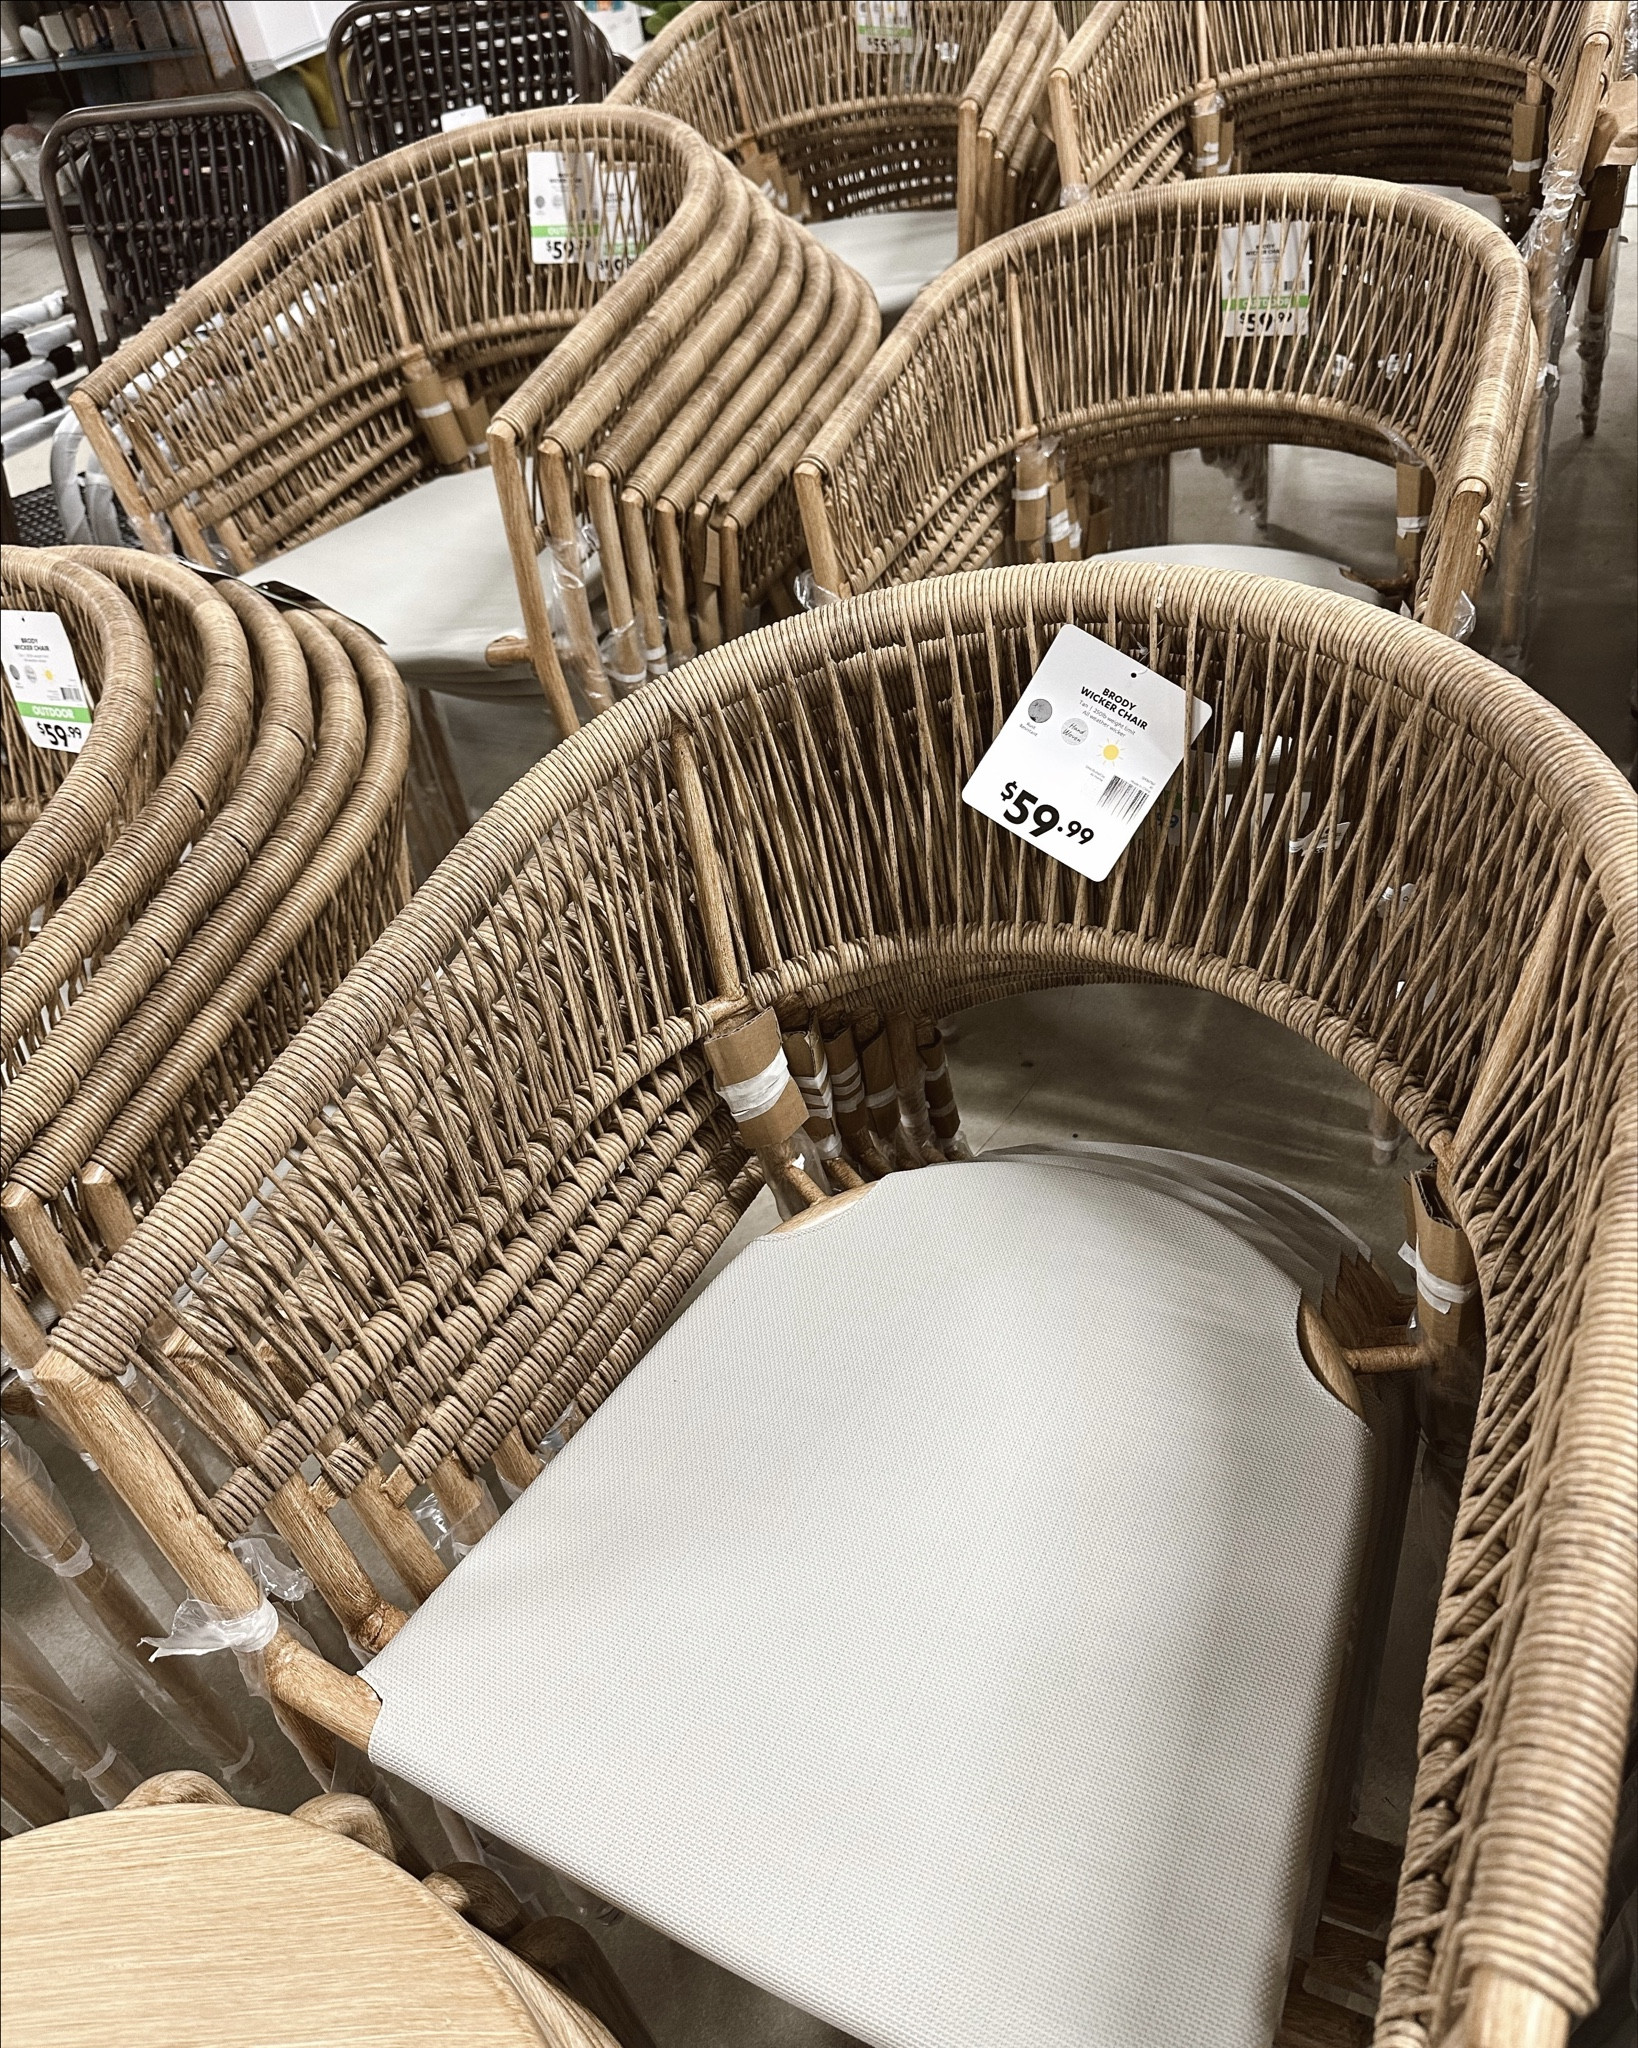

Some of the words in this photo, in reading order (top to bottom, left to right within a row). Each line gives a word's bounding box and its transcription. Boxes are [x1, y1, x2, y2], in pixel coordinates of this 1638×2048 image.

[1080, 686, 1119, 713] WICKER
[1117, 708, 1148, 730] CHAIR
[1102, 687, 1137, 711] BRODY
[32, 705, 75, 719] OUTDOOR
[1080, 700, 1089, 709] Tan
[1106, 716, 1124, 729] weight
[1124, 725, 1136, 735] limit
[37, 721, 82, 747] $59.99
[1062, 728, 1081, 742] Woven
[1069, 722, 1087, 735] Hand
[1089, 715, 1110, 730] weather
[1109, 726, 1126, 738] wicker
[1000, 781, 1094, 845] $59.99
